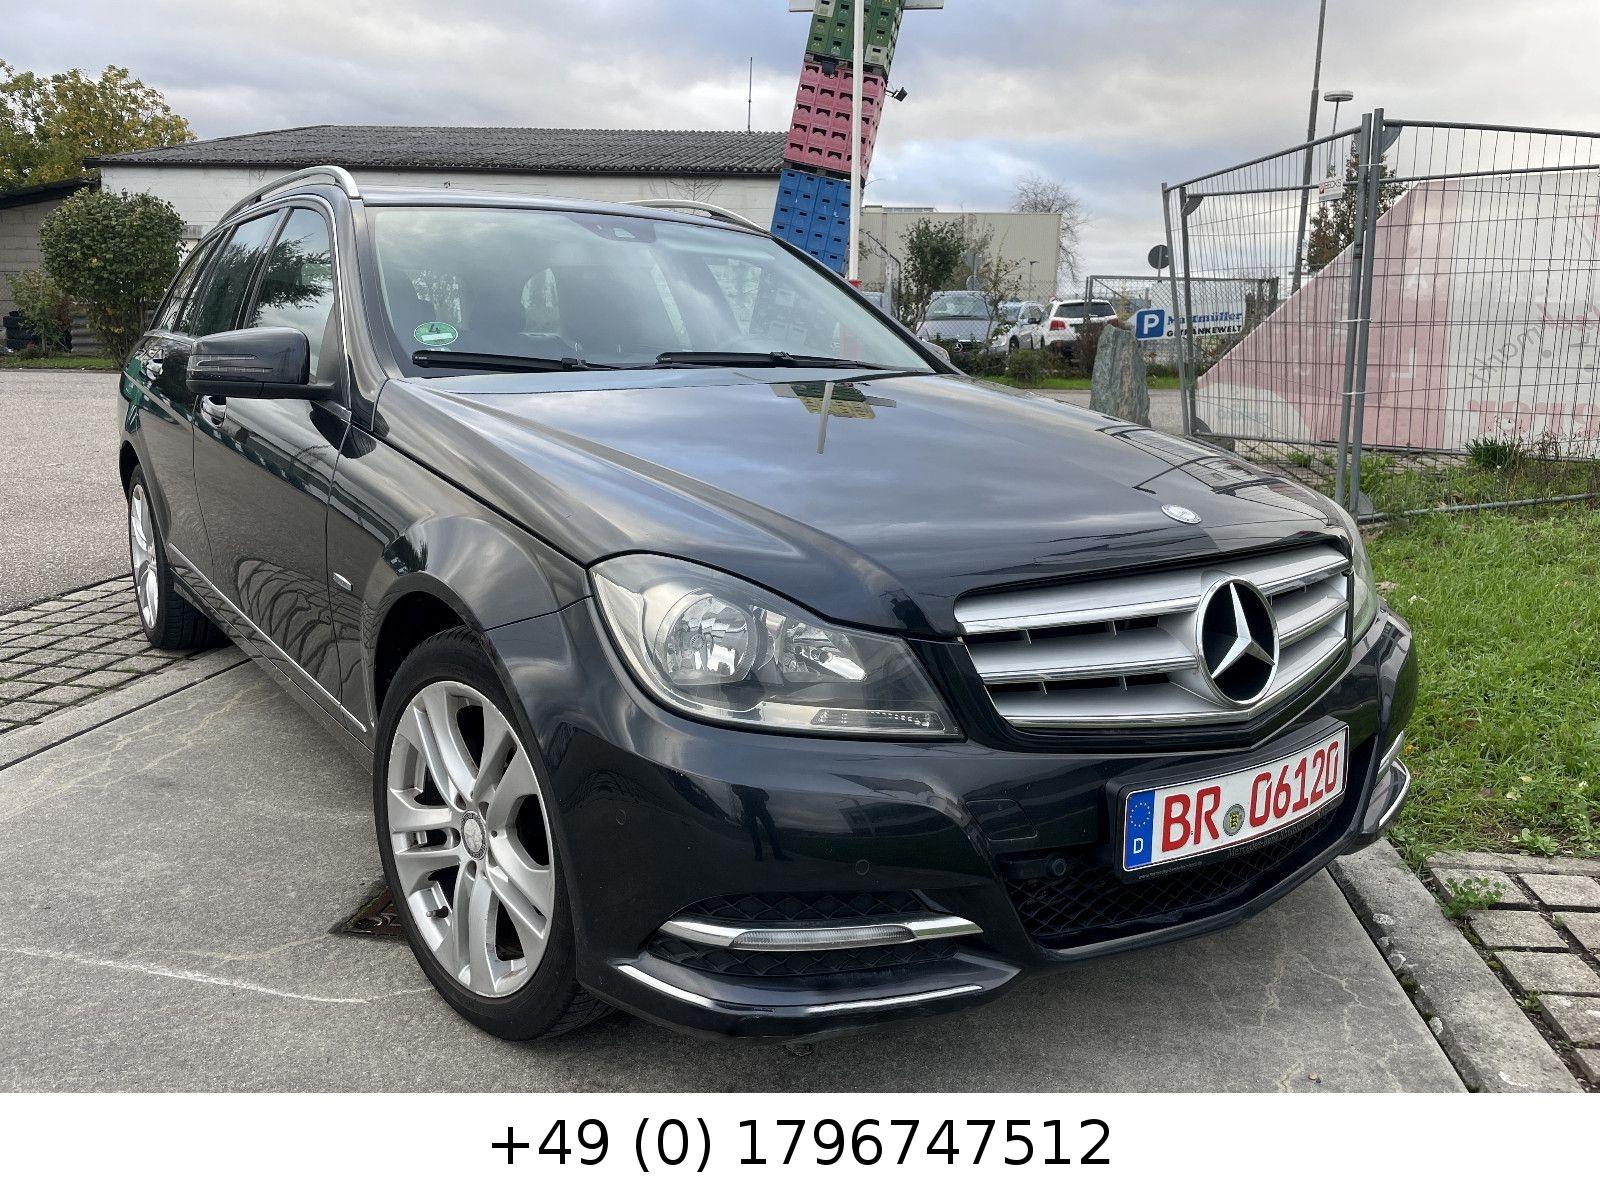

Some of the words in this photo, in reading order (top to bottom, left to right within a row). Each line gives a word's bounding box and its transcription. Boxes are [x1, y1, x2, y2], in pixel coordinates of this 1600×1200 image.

[429, 323, 441, 334] 4
[1143, 313, 1160, 335] P
[1161, 785, 1221, 853] BR
[1249, 740, 1340, 828] 06120
[1133, 836, 1144, 854] D
